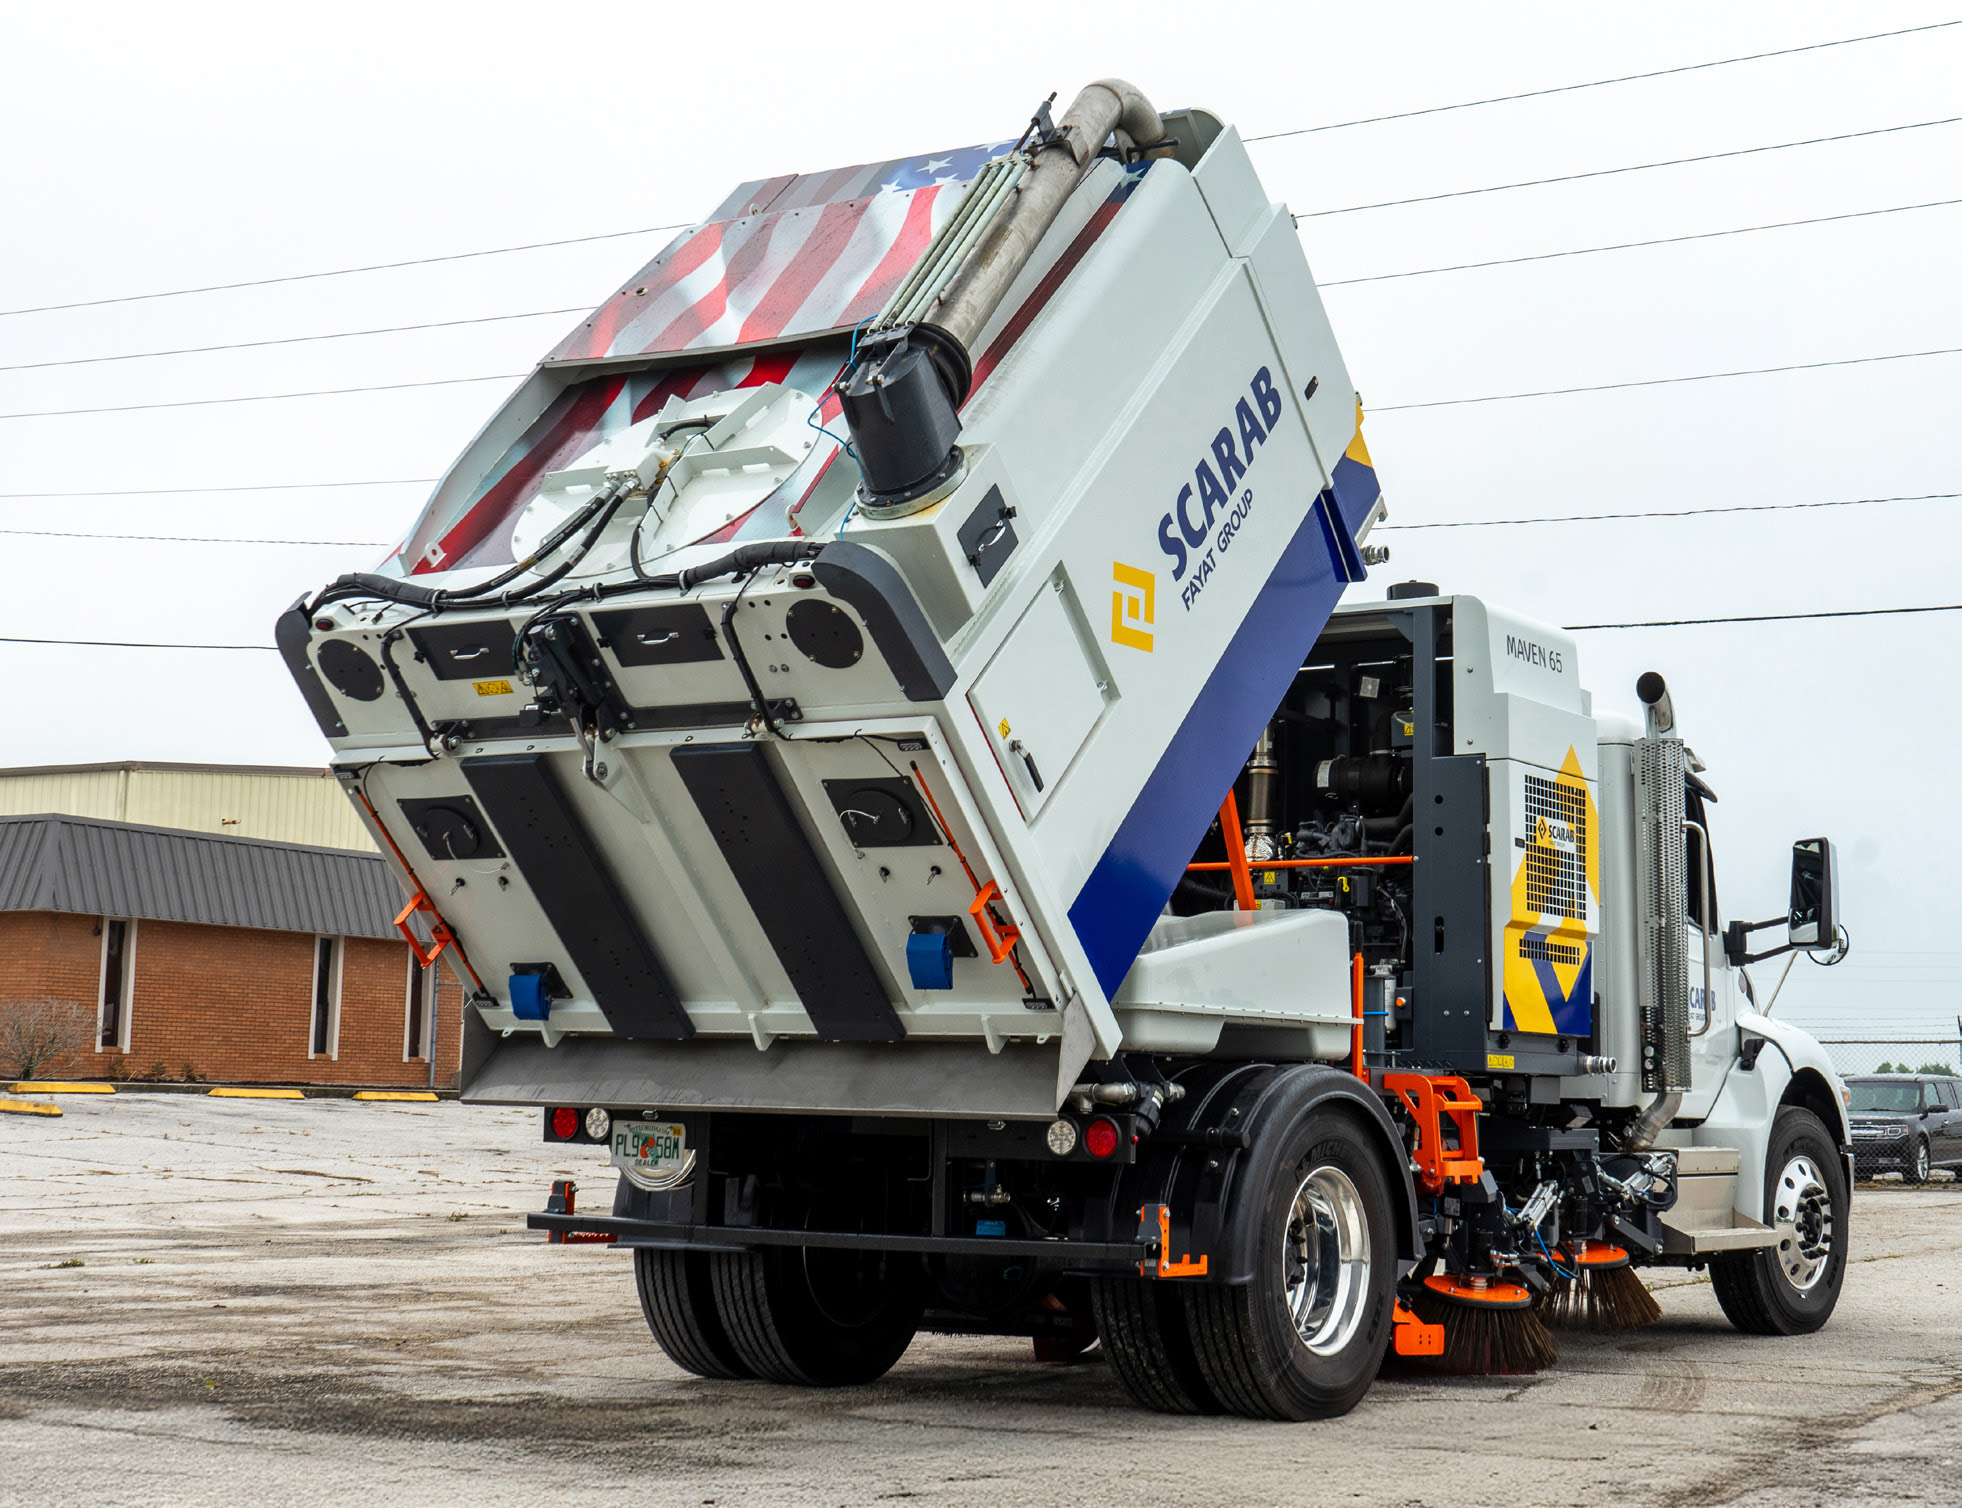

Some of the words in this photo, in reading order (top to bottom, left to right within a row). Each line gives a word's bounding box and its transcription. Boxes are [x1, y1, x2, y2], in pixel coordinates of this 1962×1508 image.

[1158, 365, 1282, 582] SCARAB
[1181, 548, 1217, 612] FAYAT
[1217, 488, 1254, 553] GROUP
[1506, 634, 1547, 668] MAVEN
[1549, 650, 1563, 673] 65
[1548, 824, 1575, 843] SCARAB
[615, 1134, 639, 1157] PL9
[634, 1158, 659, 1167] DEALER
